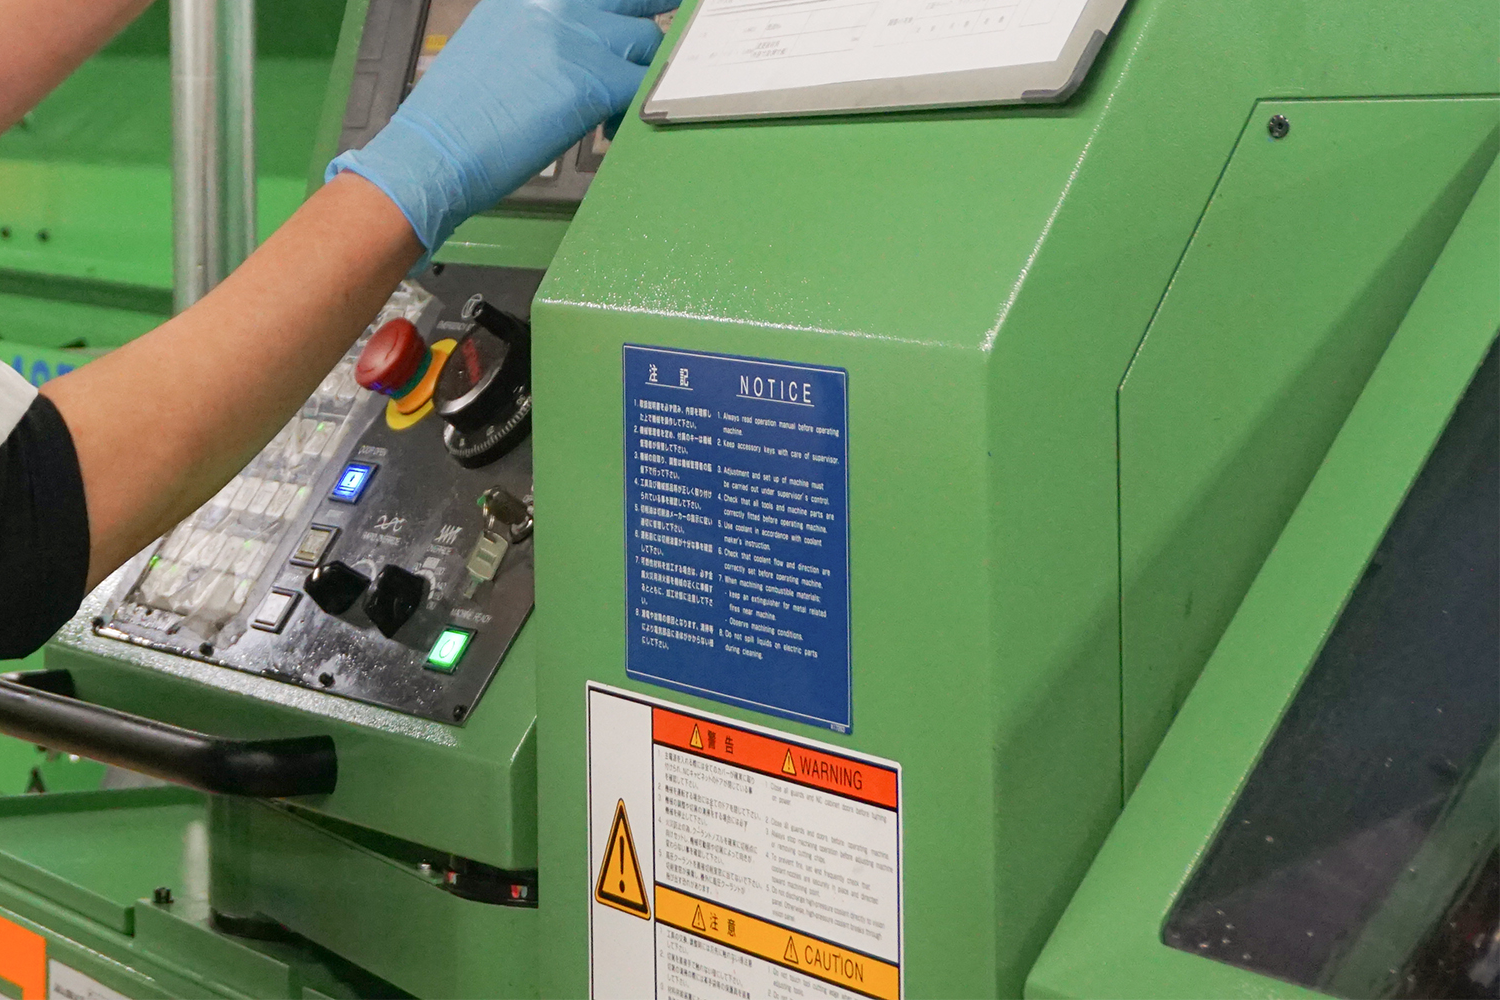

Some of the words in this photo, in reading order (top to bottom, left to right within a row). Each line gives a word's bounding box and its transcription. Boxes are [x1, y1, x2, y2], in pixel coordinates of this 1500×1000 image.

[740, 376, 811, 403] NOTICE
[723, 412, 740, 422] Always
[741, 416, 753, 424] read
[754, 418, 777, 427] operation
[778, 421, 796, 430] manual
[798, 423, 814, 432] before
[816, 427, 839, 437] operating
[723, 439, 735, 448] Keep
[737, 443, 761, 453] accessory
[763, 446, 776, 455] keys
[790, 451, 802, 459] care
[804, 452, 810, 460] of
[723, 467, 750, 477] Adjustment
[752, 472, 761, 480] and
[781, 476, 787, 484] of
[789, 479, 809, 488] machine
[811, 482, 824, 490] must
[723, 480, 730, 488] be
[731, 483, 749, 491] carried
[761, 488, 775, 496] under
[723, 494, 738, 503] Check
[740, 498, 751, 506] that
[761, 501, 774, 510] tools
[776, 504, 785, 512] and
[787, 506, 807, 516] machine
[810, 510, 823, 519] parts
[826, 513, 834, 521] are
[723, 509, 745, 519] correctly
[747, 512, 760, 521] fitted
[762, 515, 778, 524] before
[780, 519, 803, 530] operating
[724, 521, 733, 530] Use
[735, 525, 753, 533] coolant
[754, 527, 759, 535] in
[761, 530, 789, 540] accordance
[804, 537, 822, 546] coolant
[724, 536, 742, 545] maker's
[724, 548, 739, 558] Check
[741, 552, 751, 561] that
[753, 555, 771, 564] coolant
[797, 563, 819, 574] direction
[724, 563, 745, 574] correctly
[758, 569, 773, 579] before
[776, 574, 799, 585] operating
[724, 575, 737, 585] When
[739, 580, 763, 591] machining
[765, 585, 794, 597] combustible
[729, 590, 741, 600] keep
[751, 596, 780, 607] extinguisher
[782, 601, 790, 610] for
[792, 605, 807, 613] metal
[809, 608, 827, 618] related
[729, 603, 740, 613] fires
[742, 608, 753, 616] near
[729, 617, 749, 628] Observe
[751, 623, 775, 635] machining
[725, 629, 732, 638] Do
[734, 633, 742, 641] not
[744, 635, 754, 643] spill
[757, 637, 772, 647] liquids
[783, 644, 802, 654] electric
[804, 649, 818, 658] parts
[725, 644, 740, 655] during
[707, 729, 734, 755] 警告
[800, 756, 863, 791] WARNING
[708, 912, 737, 938] 注意
[804, 946, 864, 983] CAUTION
